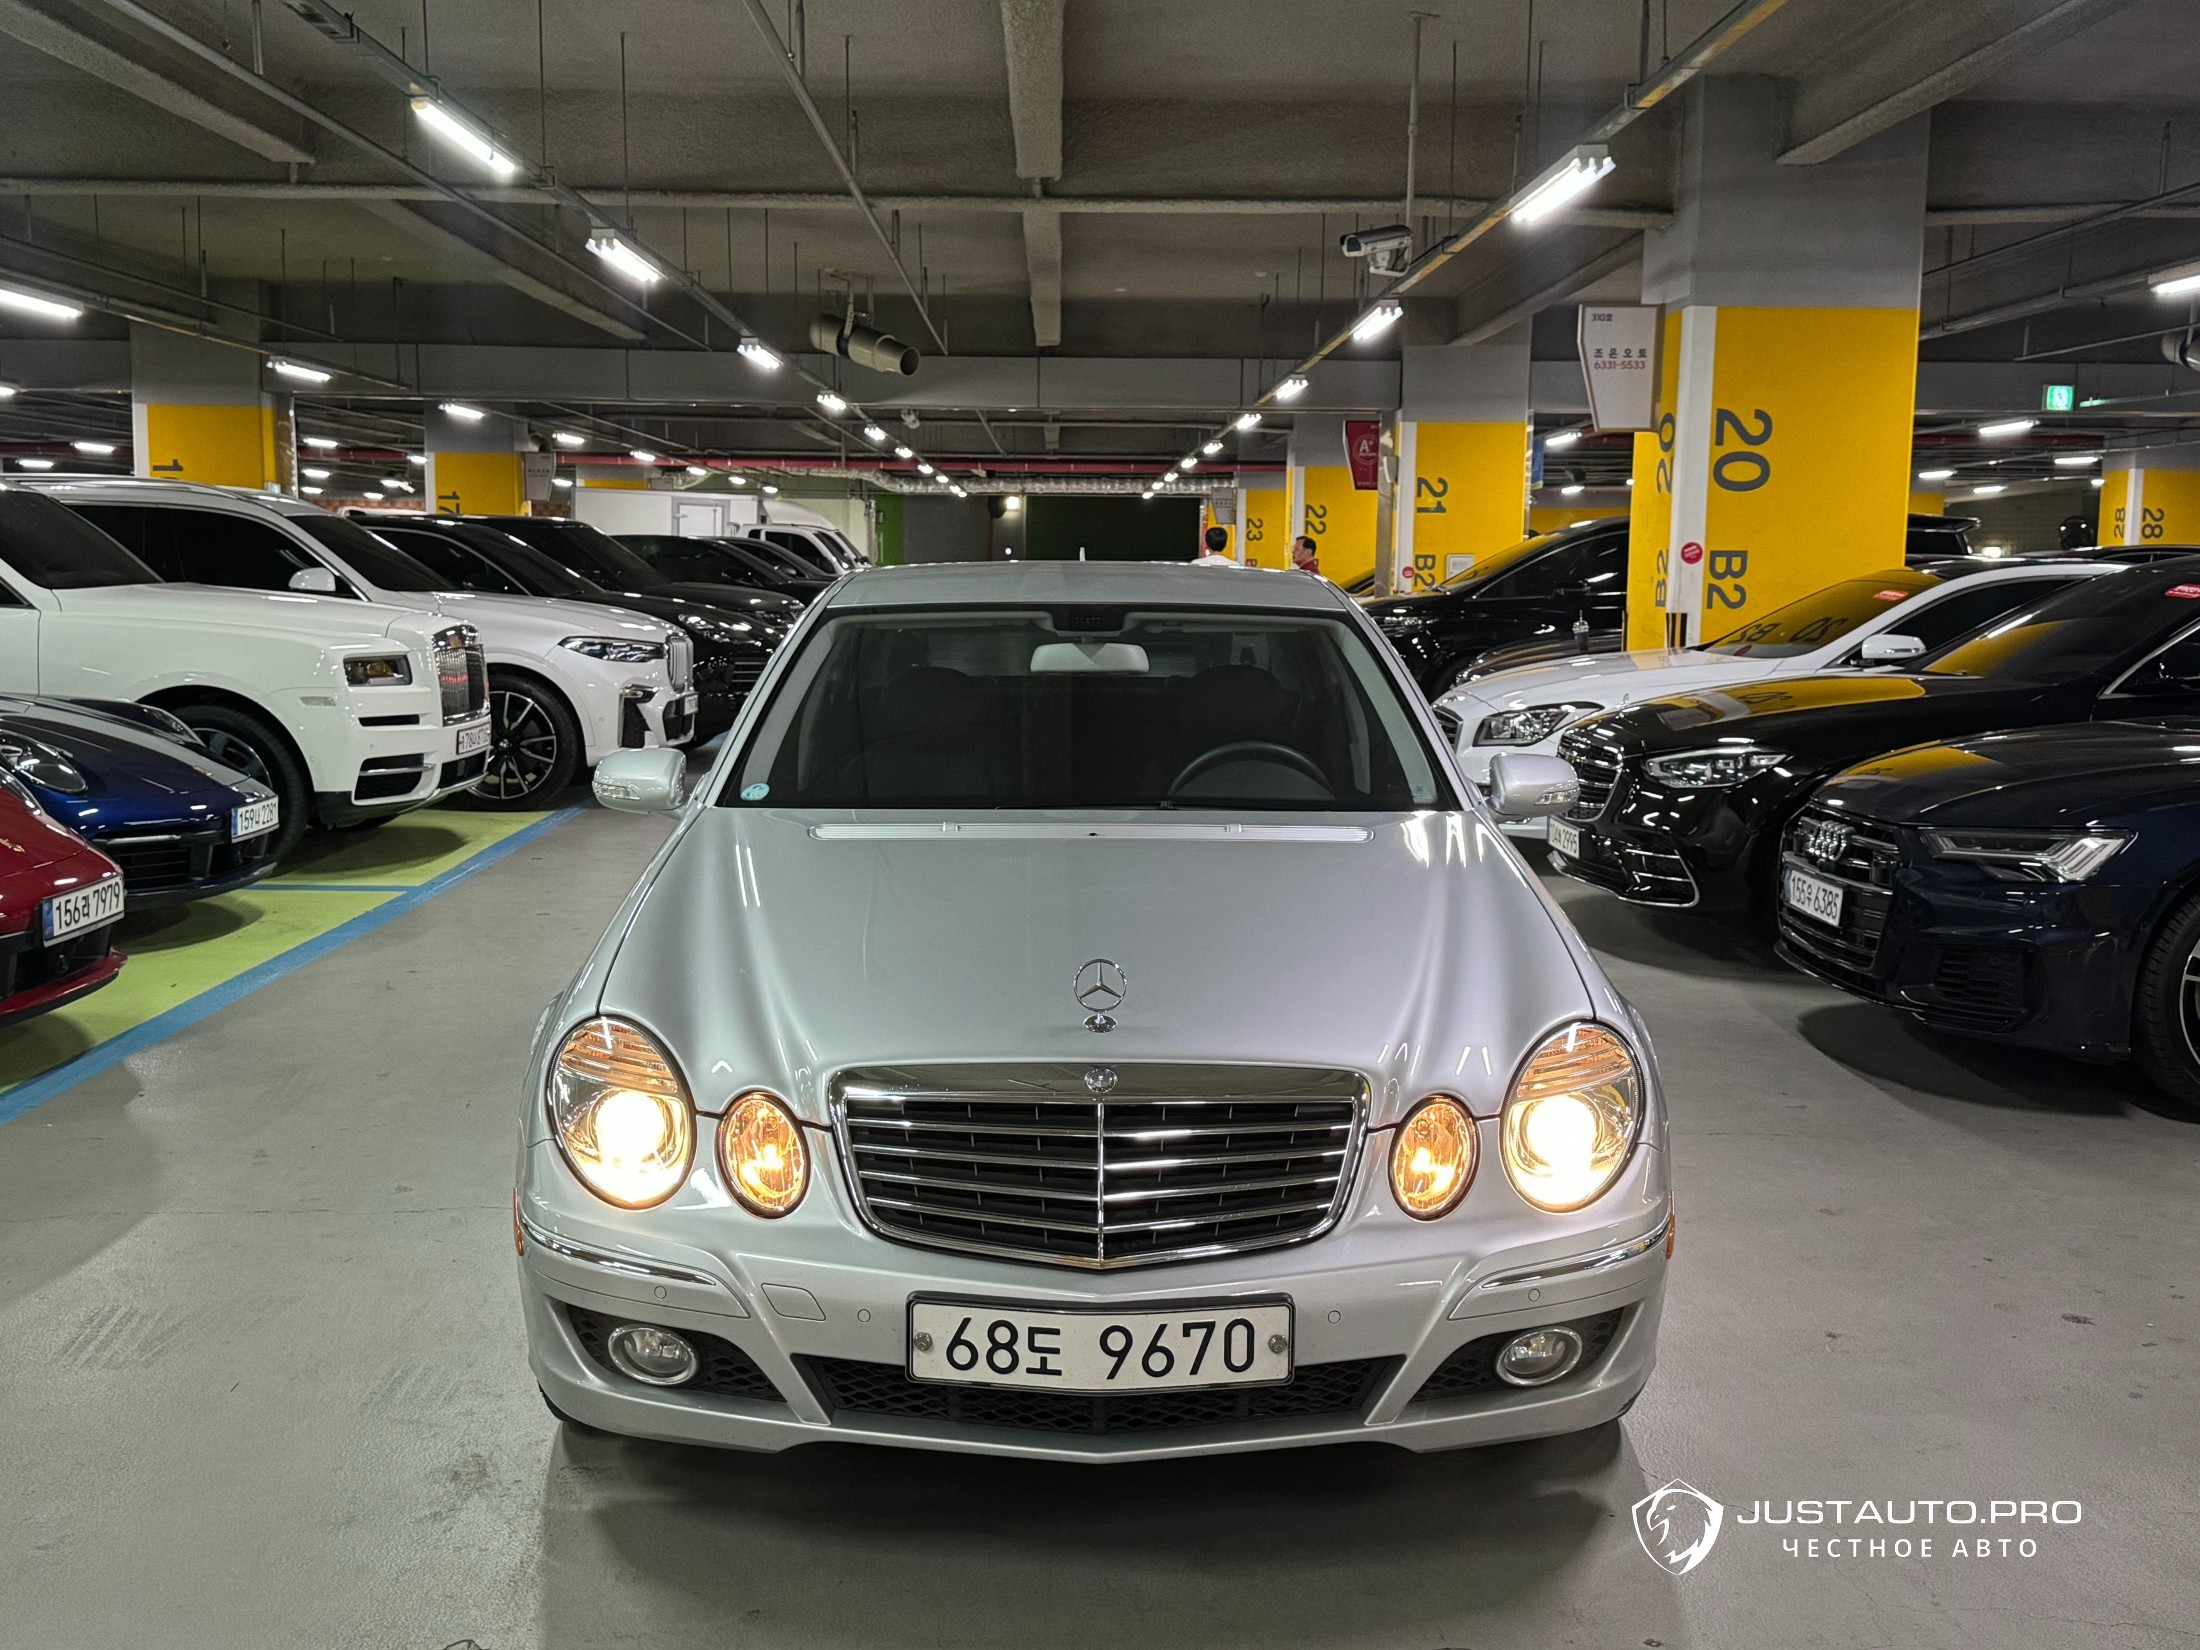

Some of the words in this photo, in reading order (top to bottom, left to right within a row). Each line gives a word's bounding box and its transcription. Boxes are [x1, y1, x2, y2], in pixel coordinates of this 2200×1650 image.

[1594, 361, 1646, 370] 6331-5533
[1657, 412, 1676, 494] 20
[1712, 408, 1774, 492] 20
[1416, 477, 1449, 514] 21
[1246, 518, 1264, 542] 23
[1305, 504, 1328, 535] 22
[2114, 508, 2126, 539] 28
[2141, 507, 2166, 539] 28
[1414, 554, 1436, 591] B2
[1706, 550, 1749, 610] B2
[55, 895, 91, 930] 156라
[92, 881, 121, 918] 7979
[1792, 875, 1812, 907] 155우
[1813, 886, 1840, 919] 6385
[945, 1317, 1063, 1377] 68도
[1099, 1317, 1255, 1380] 9670
